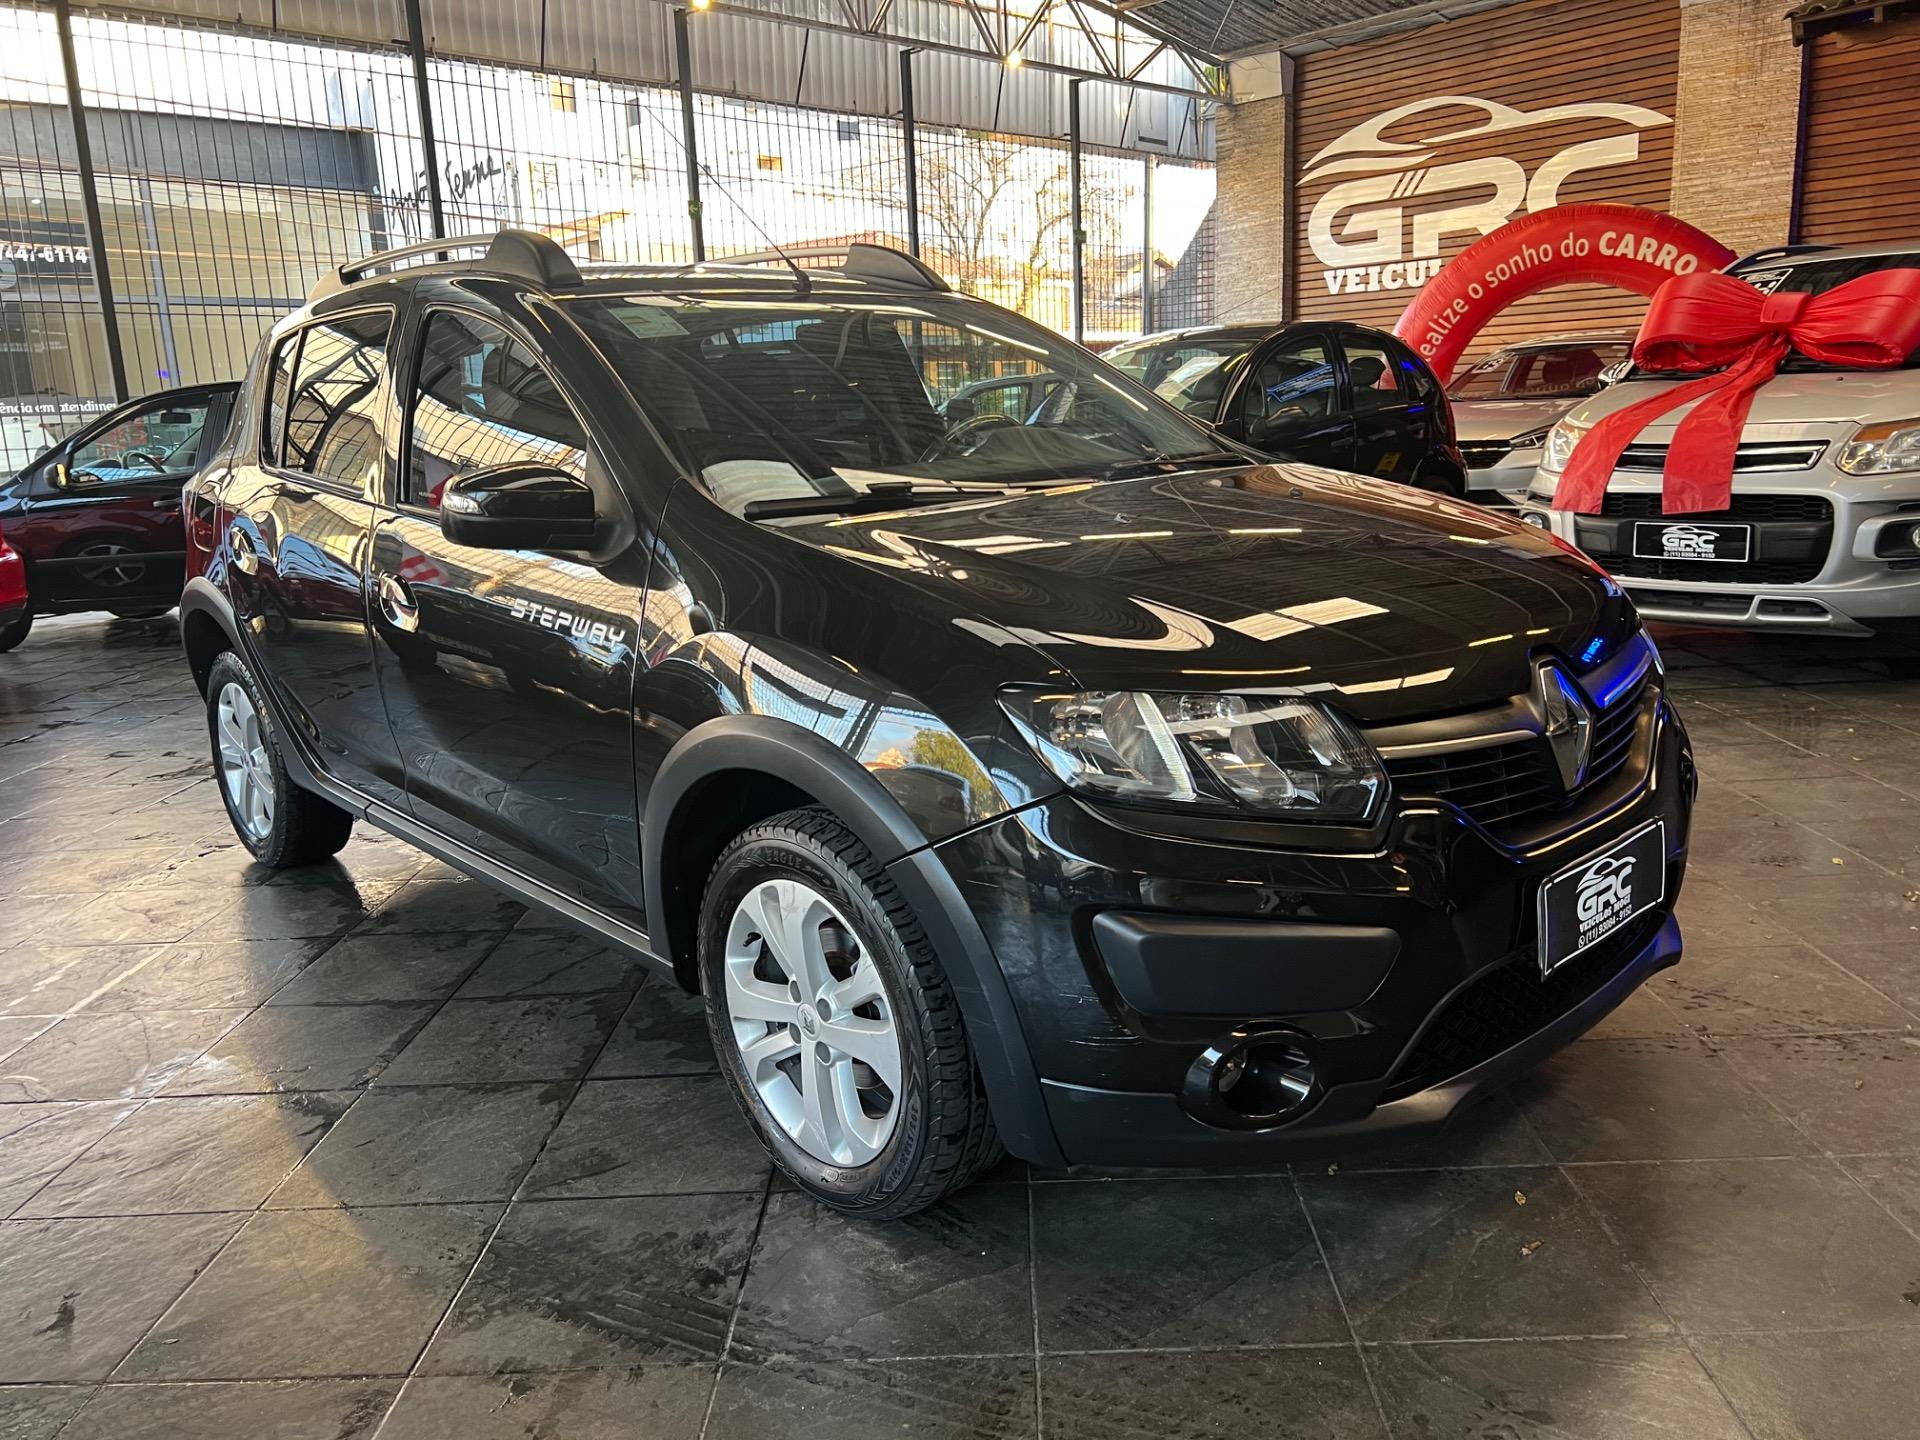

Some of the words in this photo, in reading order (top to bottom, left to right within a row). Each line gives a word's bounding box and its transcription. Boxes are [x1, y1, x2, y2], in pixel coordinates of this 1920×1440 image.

[1419, 298, 1470, 363] ealize
[1467, 283, 1484, 300] o
[1484, 243, 1553, 289] sonho
[1560, 231, 1590, 259] do
[1599, 230, 1699, 276] CARRO
[1662, 533, 1715, 549] GRC
[510, 598, 627, 649] STEPWAY
[1577, 864, 1632, 921] GRC
[1579, 906, 1612, 933] VEICULOS
